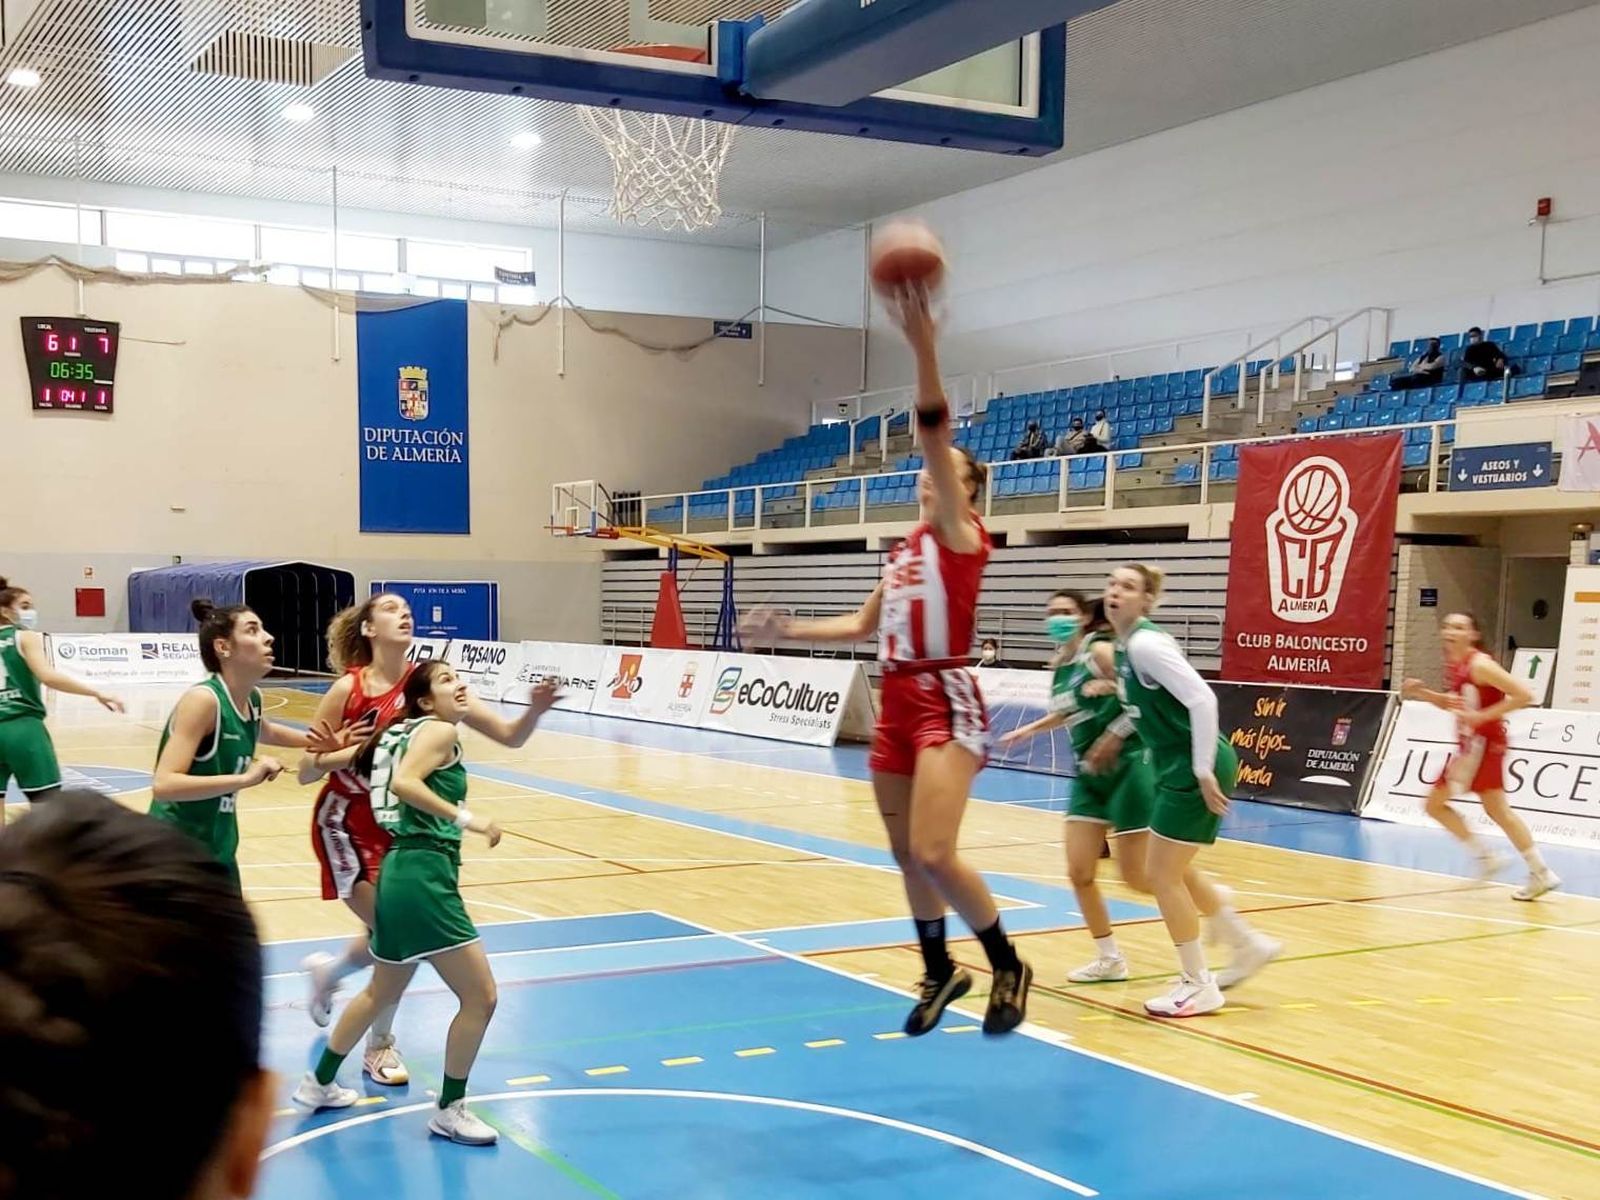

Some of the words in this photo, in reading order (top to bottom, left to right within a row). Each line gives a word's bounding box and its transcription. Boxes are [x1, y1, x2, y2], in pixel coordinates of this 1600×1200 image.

[48, 334, 58, 351] 6
[98, 338, 109, 354] 7
[51, 362, 94, 380] 06:35
[364, 427, 463, 446] DIPUTACIÓN
[366, 446, 388, 460] DE
[392, 446, 462, 463] ALMERÍA
[1481, 460, 1510, 471] ASEOS
[1513, 460, 1520, 469] Y
[1472, 472, 1527, 484] VESTUARIOS
[1278, 598, 1329, 613] ALMERIA
[79, 646, 129, 656] Roman
[162, 642, 198, 652] REAL
[1237, 633, 1271, 648] CLUB
[1275, 634, 1368, 652] BALONCESTO
[1267, 655, 1331, 673] ALMERÍA
[738, 679, 839, 714] eCoCulture
[1254, 697, 1276, 717] Sin
[769, 712, 790, 723] Stress
[790, 715, 832, 729] Specialists
[1230, 728, 1257, 749] más
[1307, 749, 1360, 761] DIPUTACIÓN
[1234, 759, 1273, 787] lmería
[1306, 759, 1317, 768] DE
[1319, 761, 1355, 772] ALMERÍA
